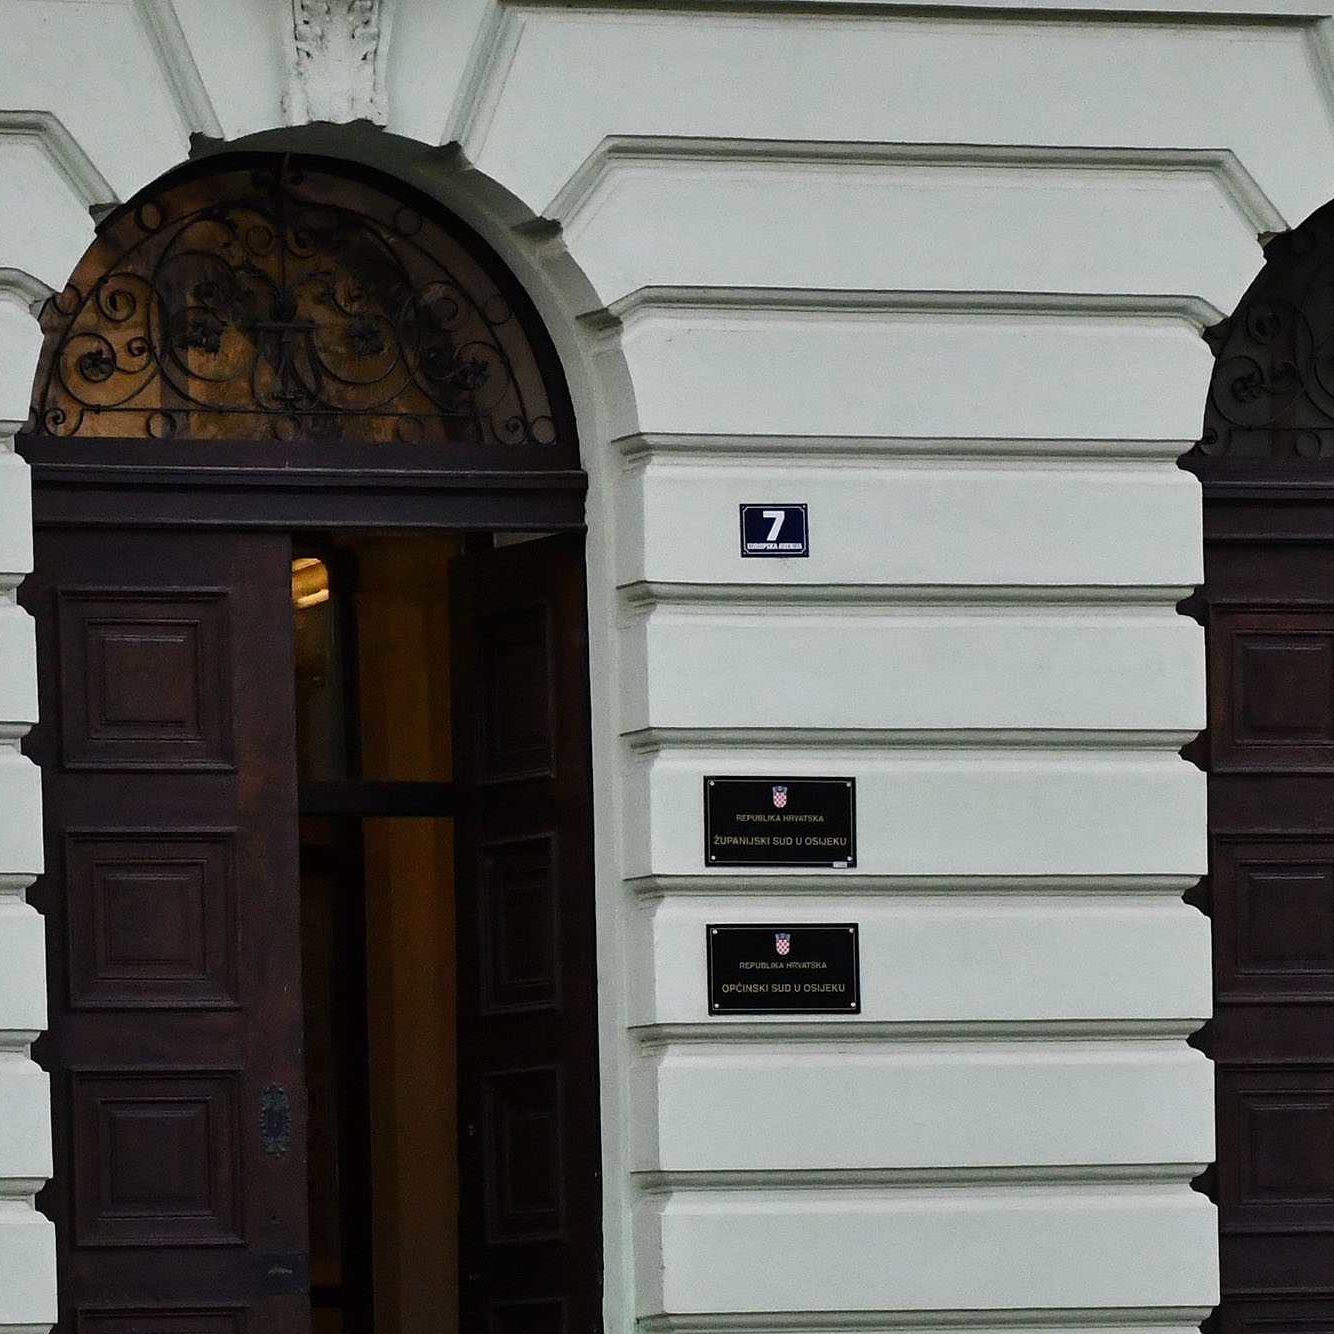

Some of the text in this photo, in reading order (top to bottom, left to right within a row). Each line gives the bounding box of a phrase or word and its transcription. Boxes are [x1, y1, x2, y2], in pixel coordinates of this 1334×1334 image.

[762, 510, 785, 541] 7
[736, 814, 824, 822] REPUBLIKA HRVATSKA
[714, 834, 847, 846] ŽUPANIJSKI SUD U OSIJEKU
[739, 961, 827, 969] REPUBLIKA HRVATSKA
[722, 982, 845, 993] OPĆINSKI SUD U OSIJEKU
